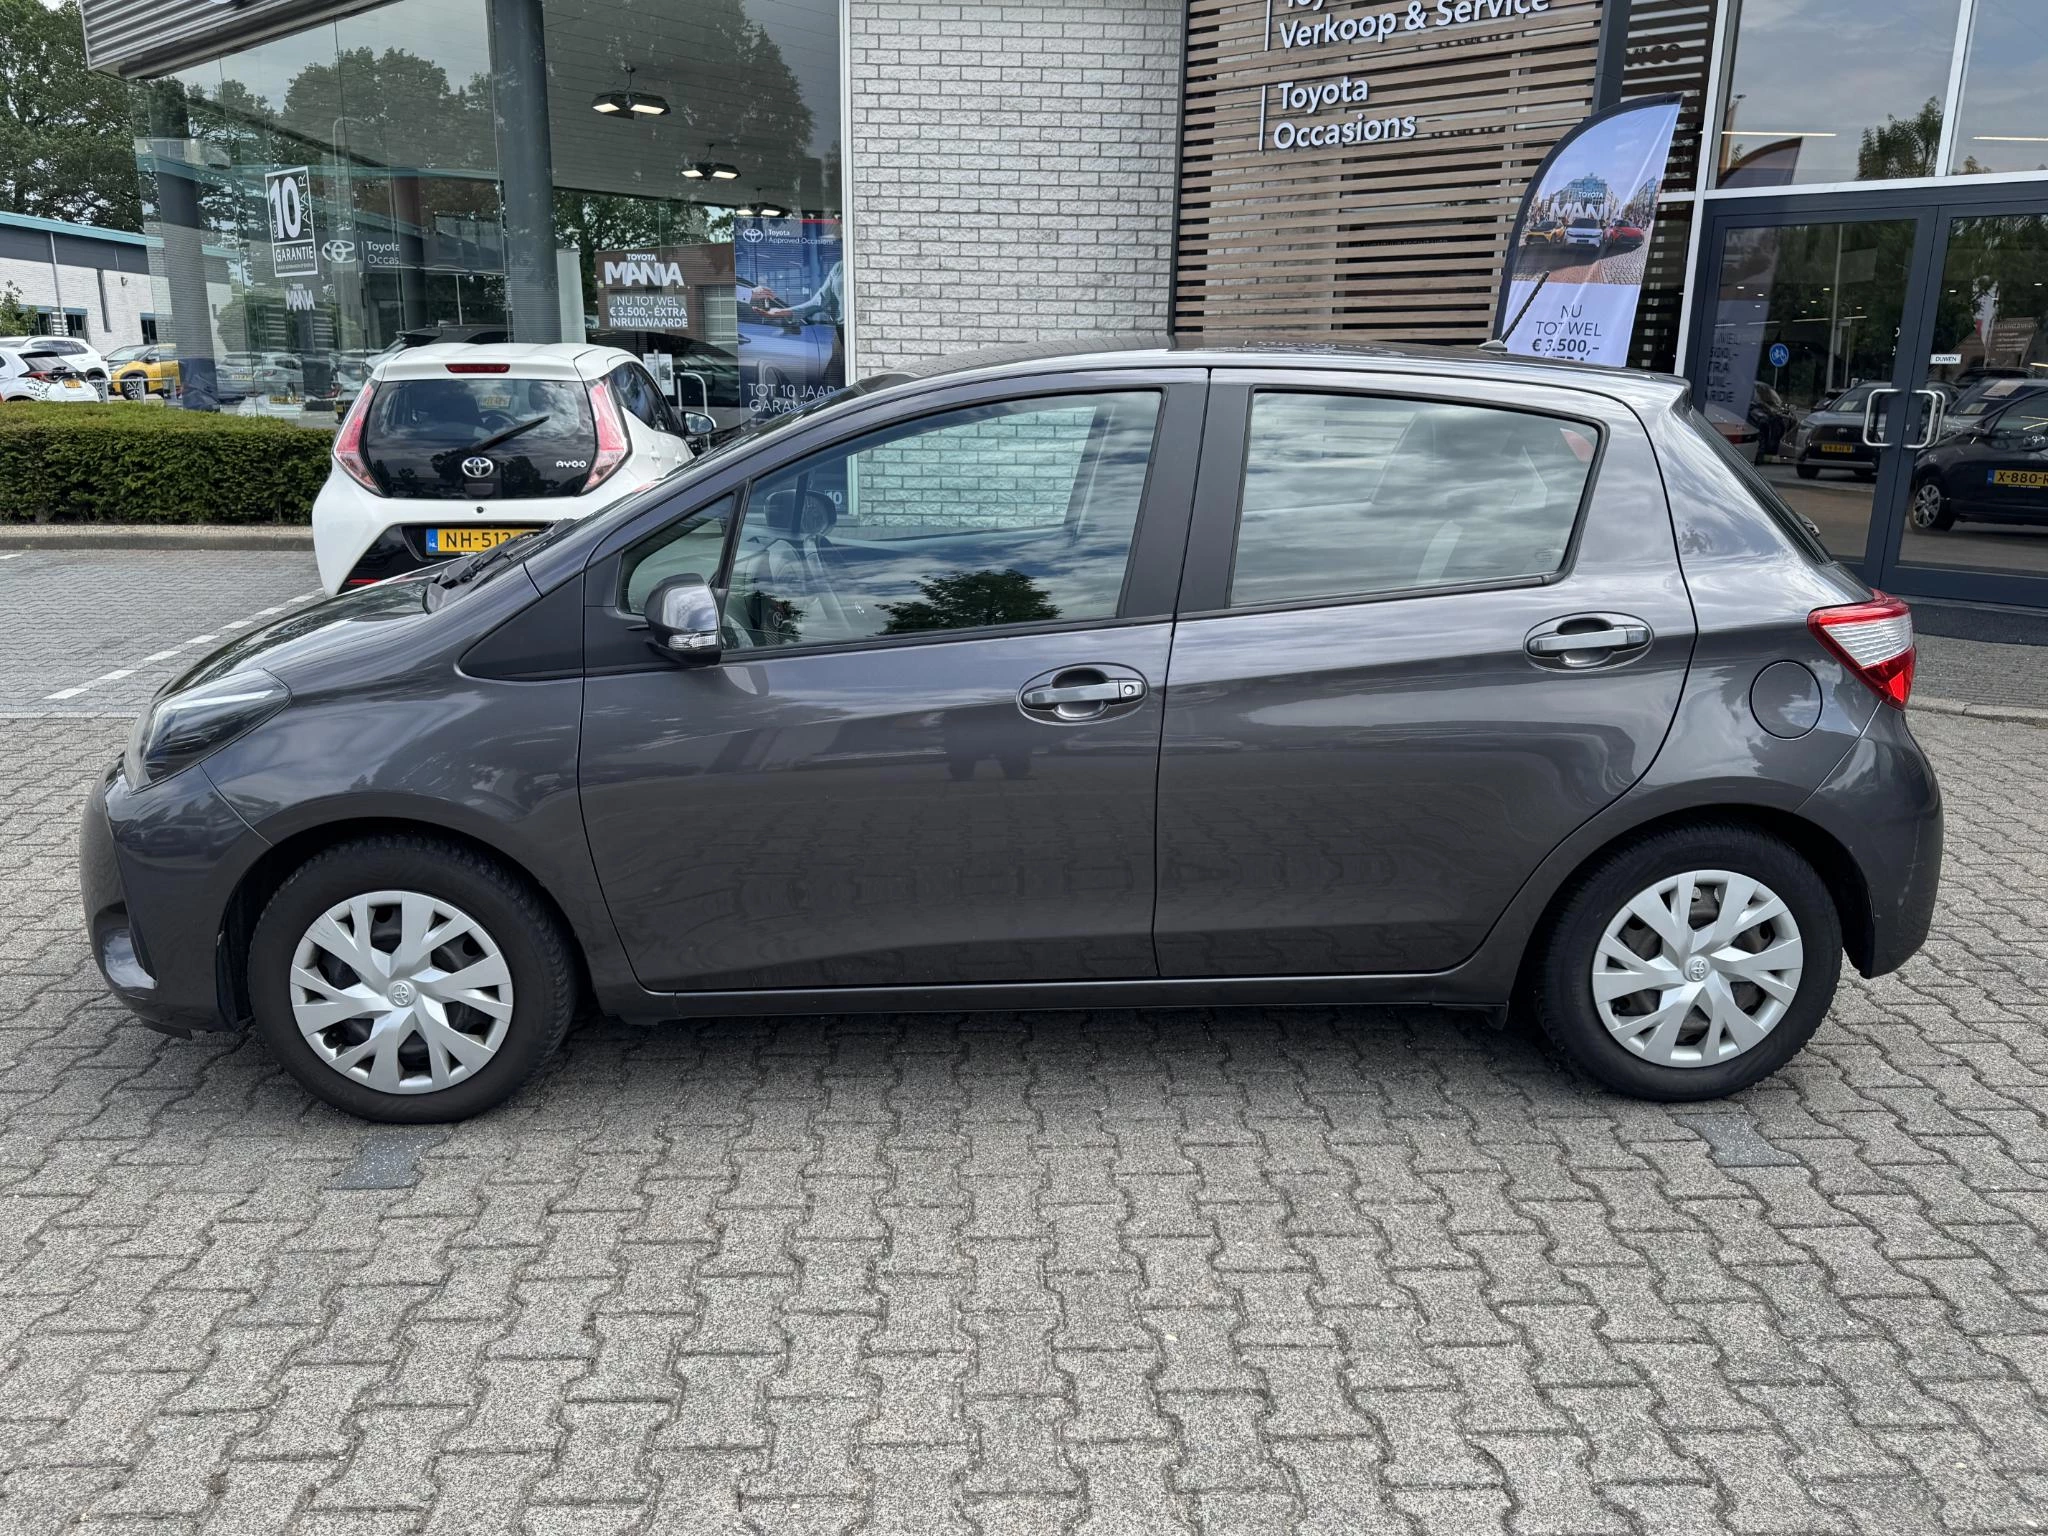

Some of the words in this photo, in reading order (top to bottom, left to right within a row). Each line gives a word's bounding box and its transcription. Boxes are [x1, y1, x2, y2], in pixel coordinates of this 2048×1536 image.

[1279, 12, 1397, 49] Verkoop
[1404, 0, 1427, 31] &
[1436, 0, 1549, 27] Service
[1277, 76, 1369, 114] Toyota
[1273, 113, 1417, 150] Occasions
[1578, 191, 1603, 199] TOYOTA
[269, 176, 301, 239] 10
[298, 174, 312, 236] JAAR
[768, 229, 790, 237] Toyota
[769, 237, 800, 245] Approved
[275, 246, 314, 262] GARANTIE
[626, 253, 657, 262] TOYOTA
[604, 261, 685, 287] MANIA
[285, 289, 316, 312] MANIA
[617, 296, 632, 306] NU
[636, 296, 654, 306] TOT
[656, 296, 679, 306] WEL
[654, 307, 687, 317] EXTRA
[1560, 304, 1583, 318] NU
[609, 317, 688, 328] INRUILWAARDE
[1536, 321, 1564, 336] TOT
[1568, 321, 1602, 337] WEL
[748, 383, 777, 397] TOT
[781, 384, 796, 398] 10
